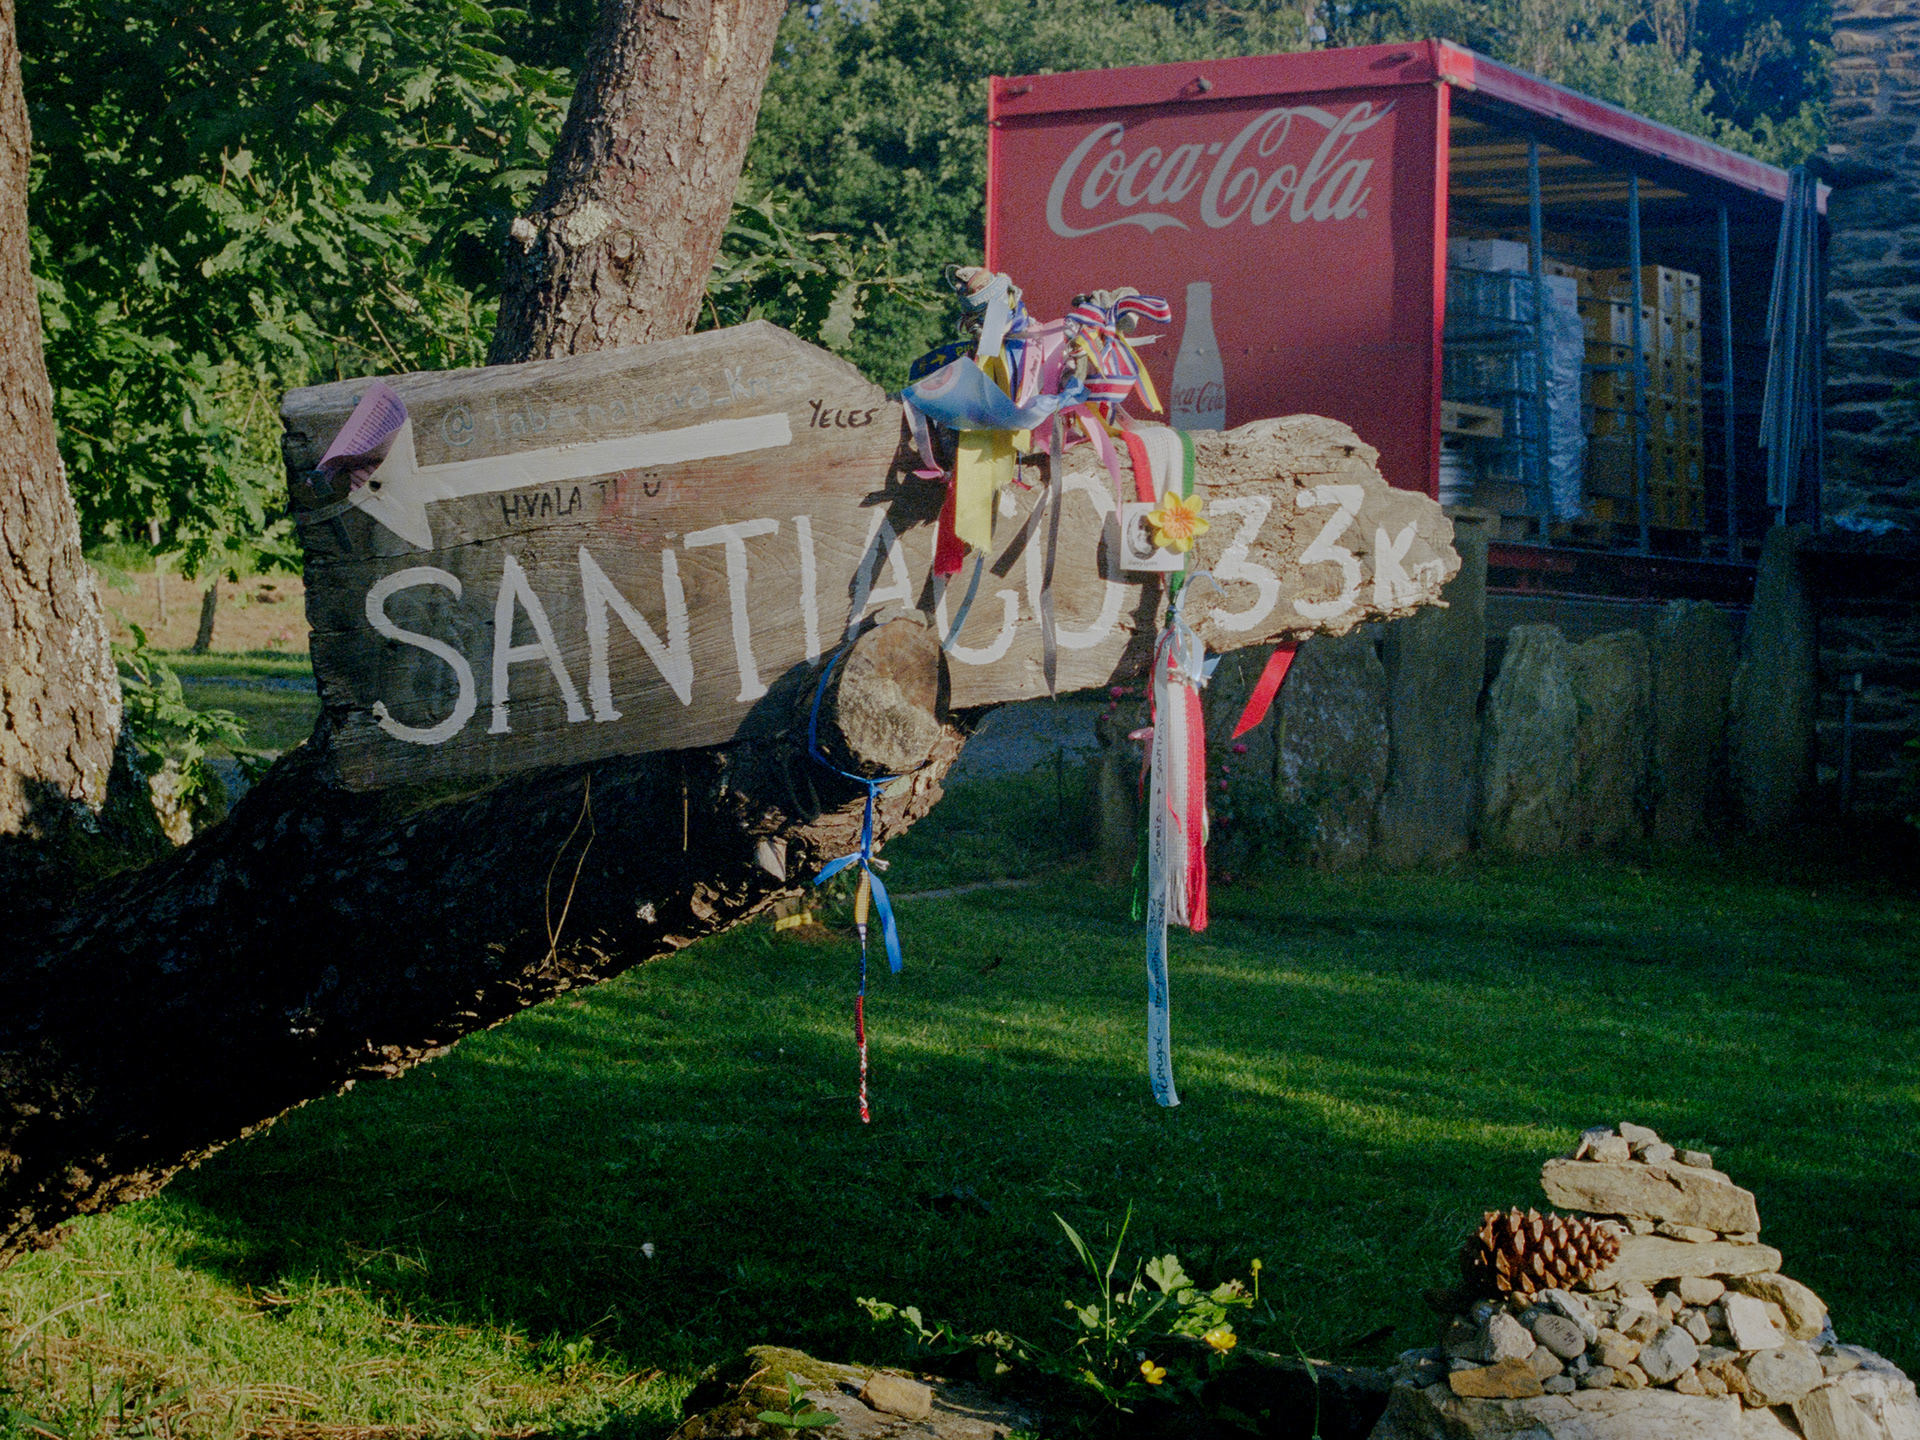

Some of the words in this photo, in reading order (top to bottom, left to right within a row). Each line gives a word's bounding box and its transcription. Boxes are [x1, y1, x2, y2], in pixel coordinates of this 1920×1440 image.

[1046, 99, 1397, 238] Coca-Cola
[808, 399, 880, 428] YELES
[500, 486, 584, 527] HVALA
[366, 470, 1126, 746] SANTIAGO
